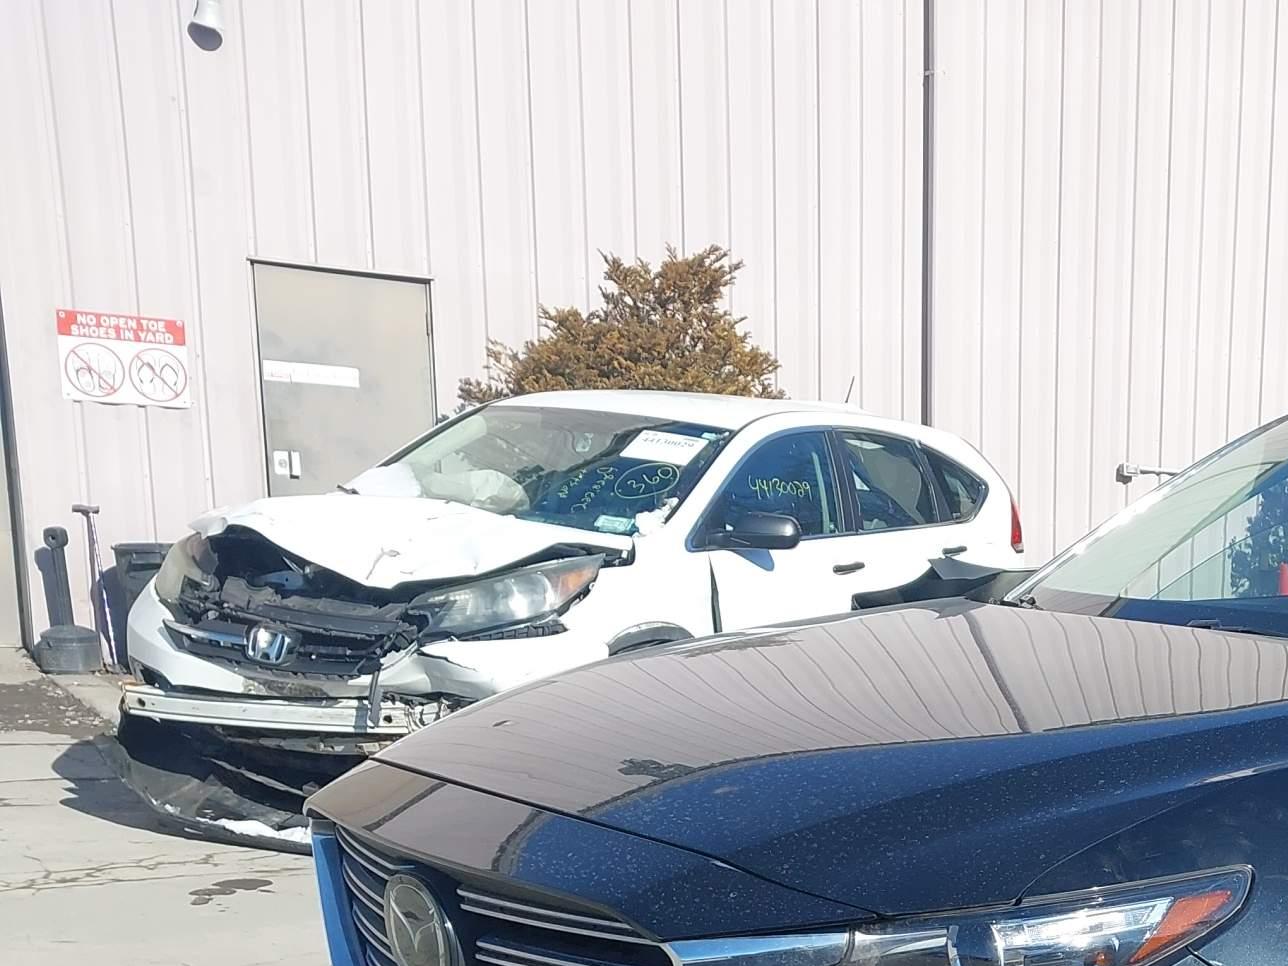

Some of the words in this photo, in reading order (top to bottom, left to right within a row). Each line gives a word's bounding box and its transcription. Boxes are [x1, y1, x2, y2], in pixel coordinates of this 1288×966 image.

[71, 324, 116, 339] SHOES
[120, 329, 135, 341] IN
[138, 331, 174, 344] YARD
[76, 313, 96, 325] NO
[100, 316, 136, 329] OPEN
[141, 319, 166, 332] TOE
[626, 466, 673, 493] 360
[748, 474, 813, 502] 44130029
